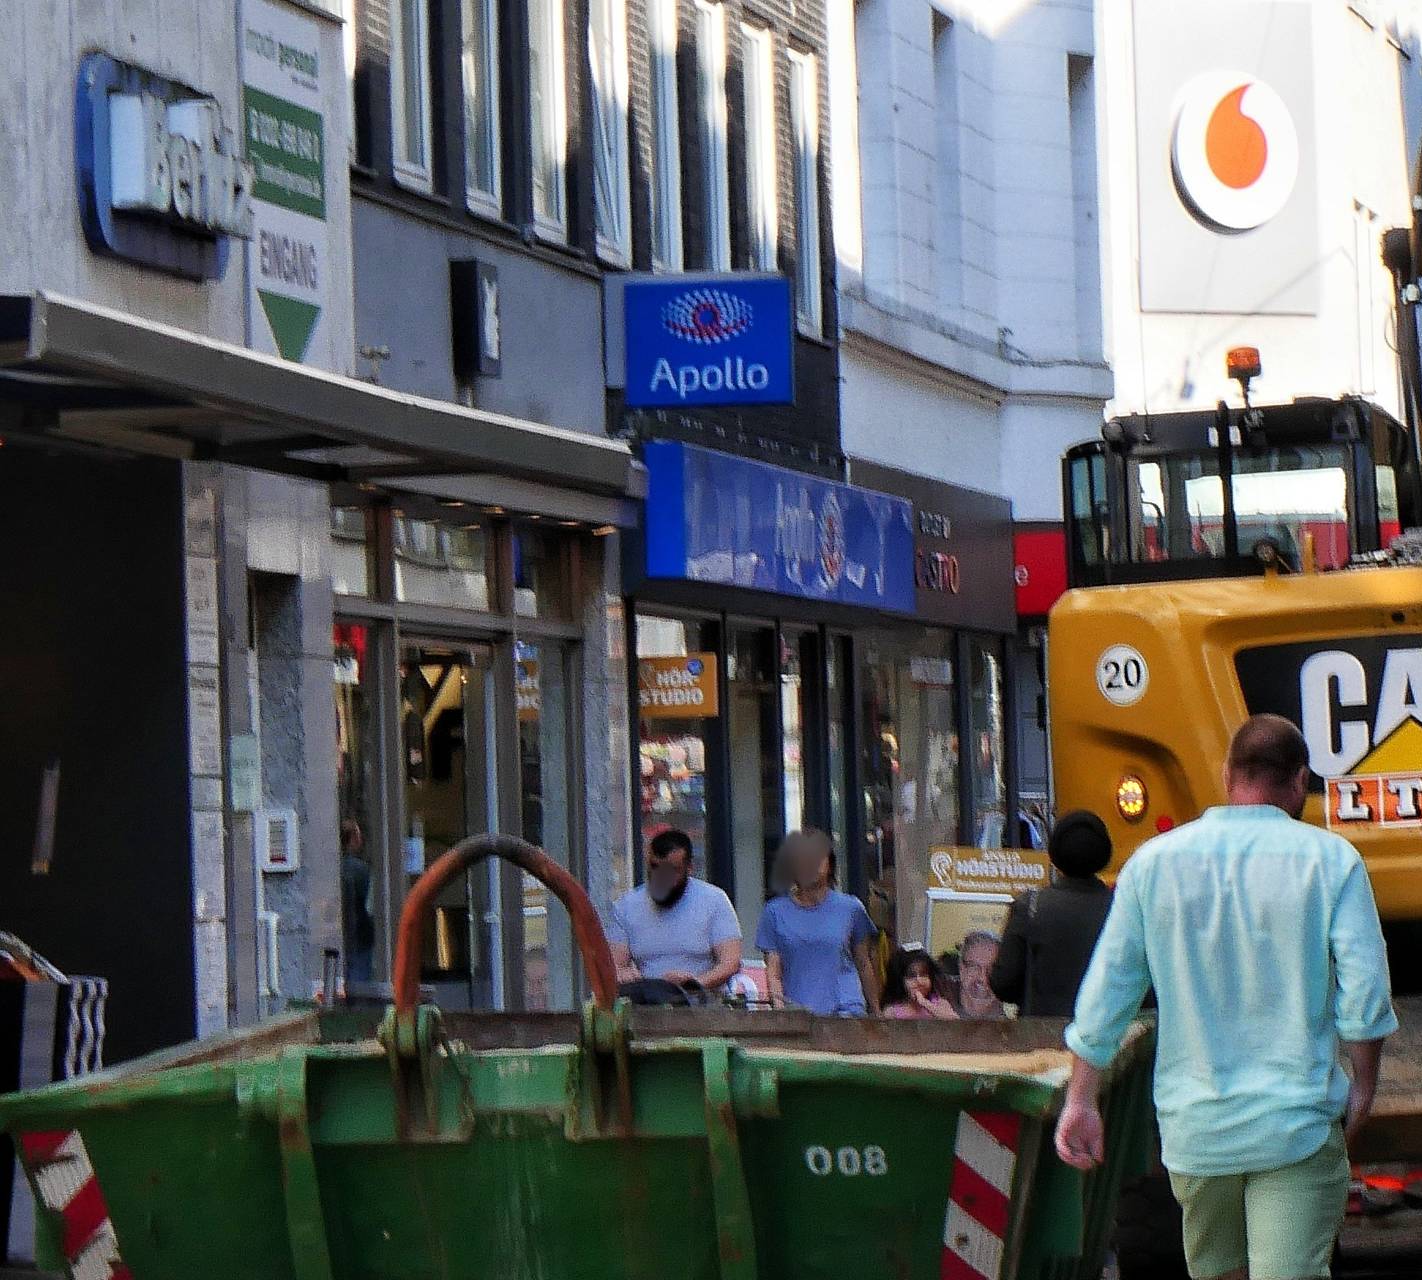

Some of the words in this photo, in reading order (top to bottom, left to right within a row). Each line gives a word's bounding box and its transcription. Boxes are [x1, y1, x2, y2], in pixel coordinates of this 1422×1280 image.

[259, 228, 318, 290] EINGANG
[650, 356, 768, 399] Apollo
[1104, 658, 1140, 689] 20
[639, 687, 704, 706] STUDIO
[805, 1144, 888, 1177] 008
